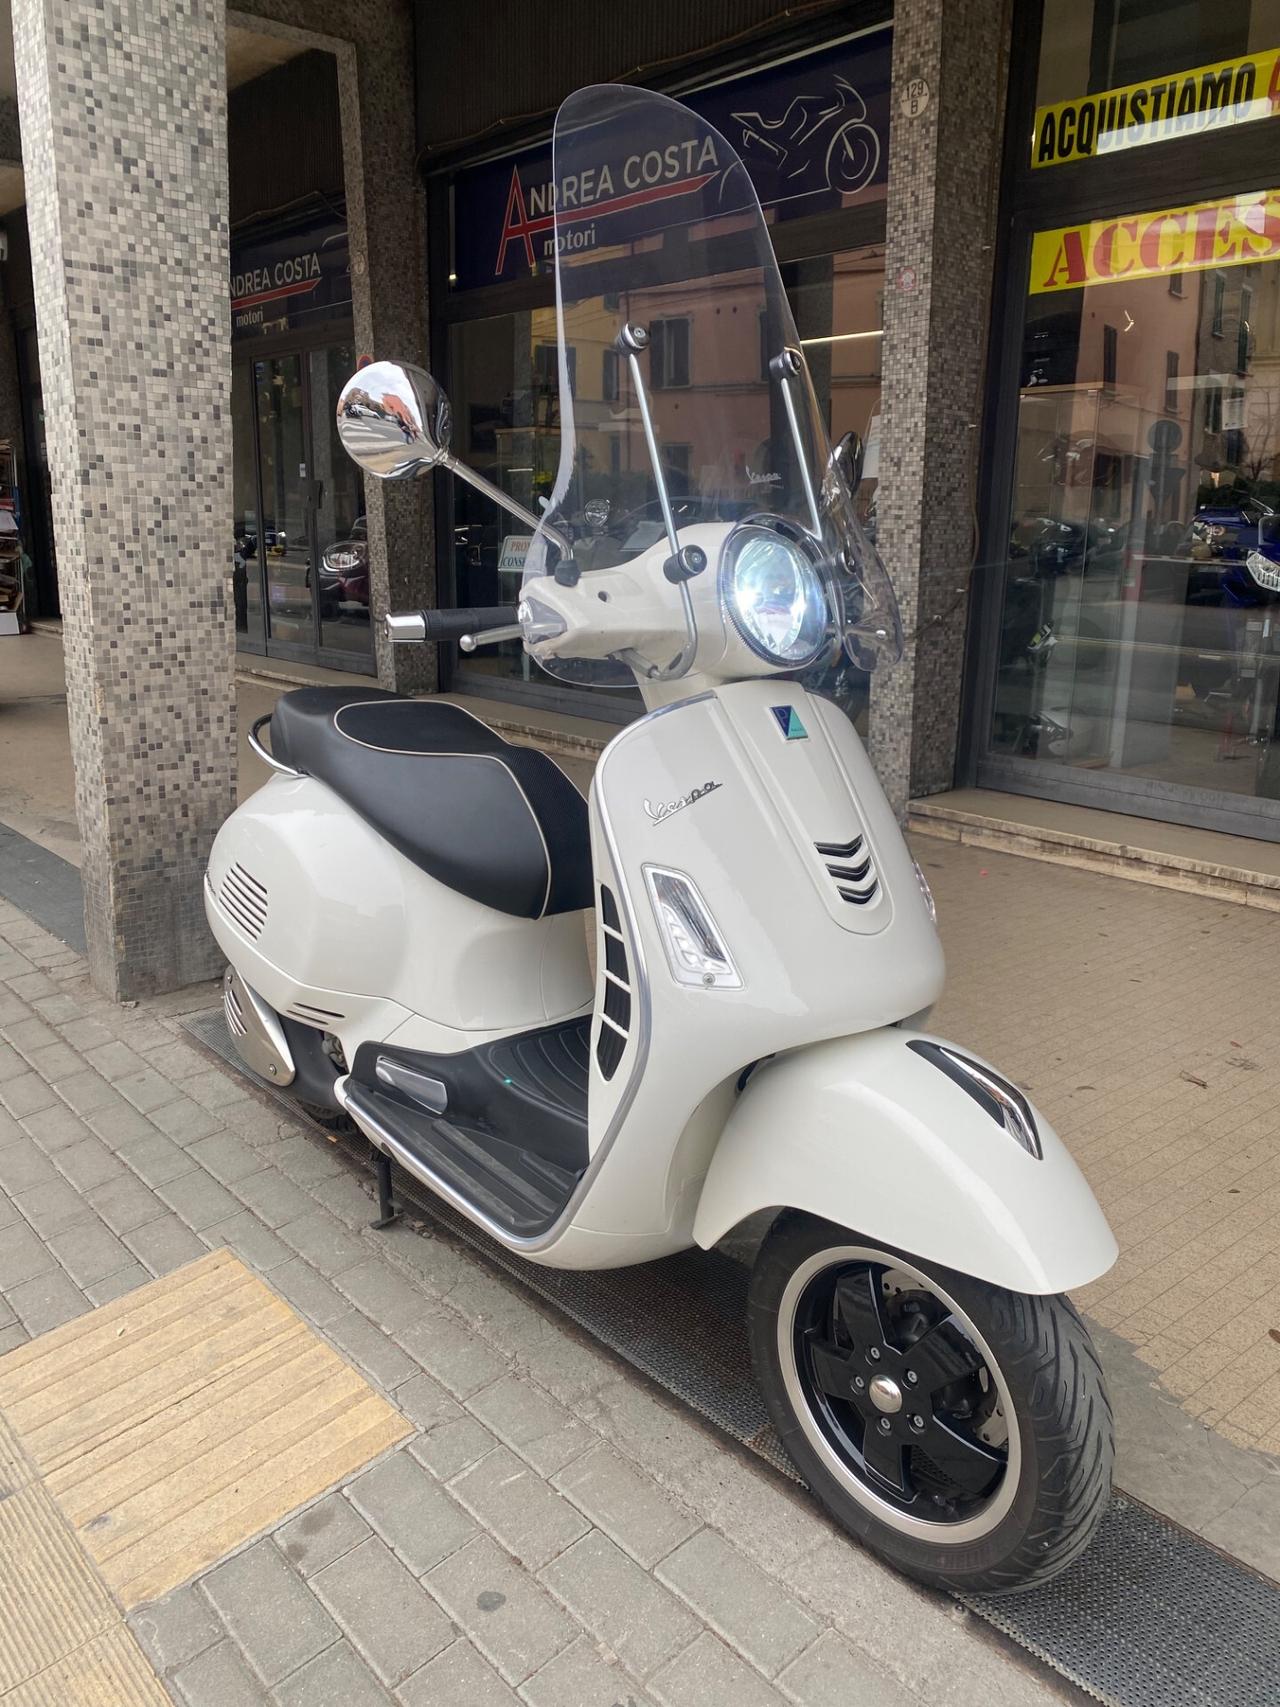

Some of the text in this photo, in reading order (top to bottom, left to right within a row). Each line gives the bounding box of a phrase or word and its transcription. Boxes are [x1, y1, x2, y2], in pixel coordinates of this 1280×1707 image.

[907, 81, 923, 99] 129
[911, 100, 918, 114] B
[1037, 62, 1257, 163] ACQUISTIAMO
[495, 135, 719, 276] ANDREA COSTA
[543, 222, 596, 256] motori
[1043, 195, 1280, 287] ACCES
[274, 252, 321, 285] COSTA
[236, 305, 264, 328] motori
[643, 780, 723, 827] Vespa
